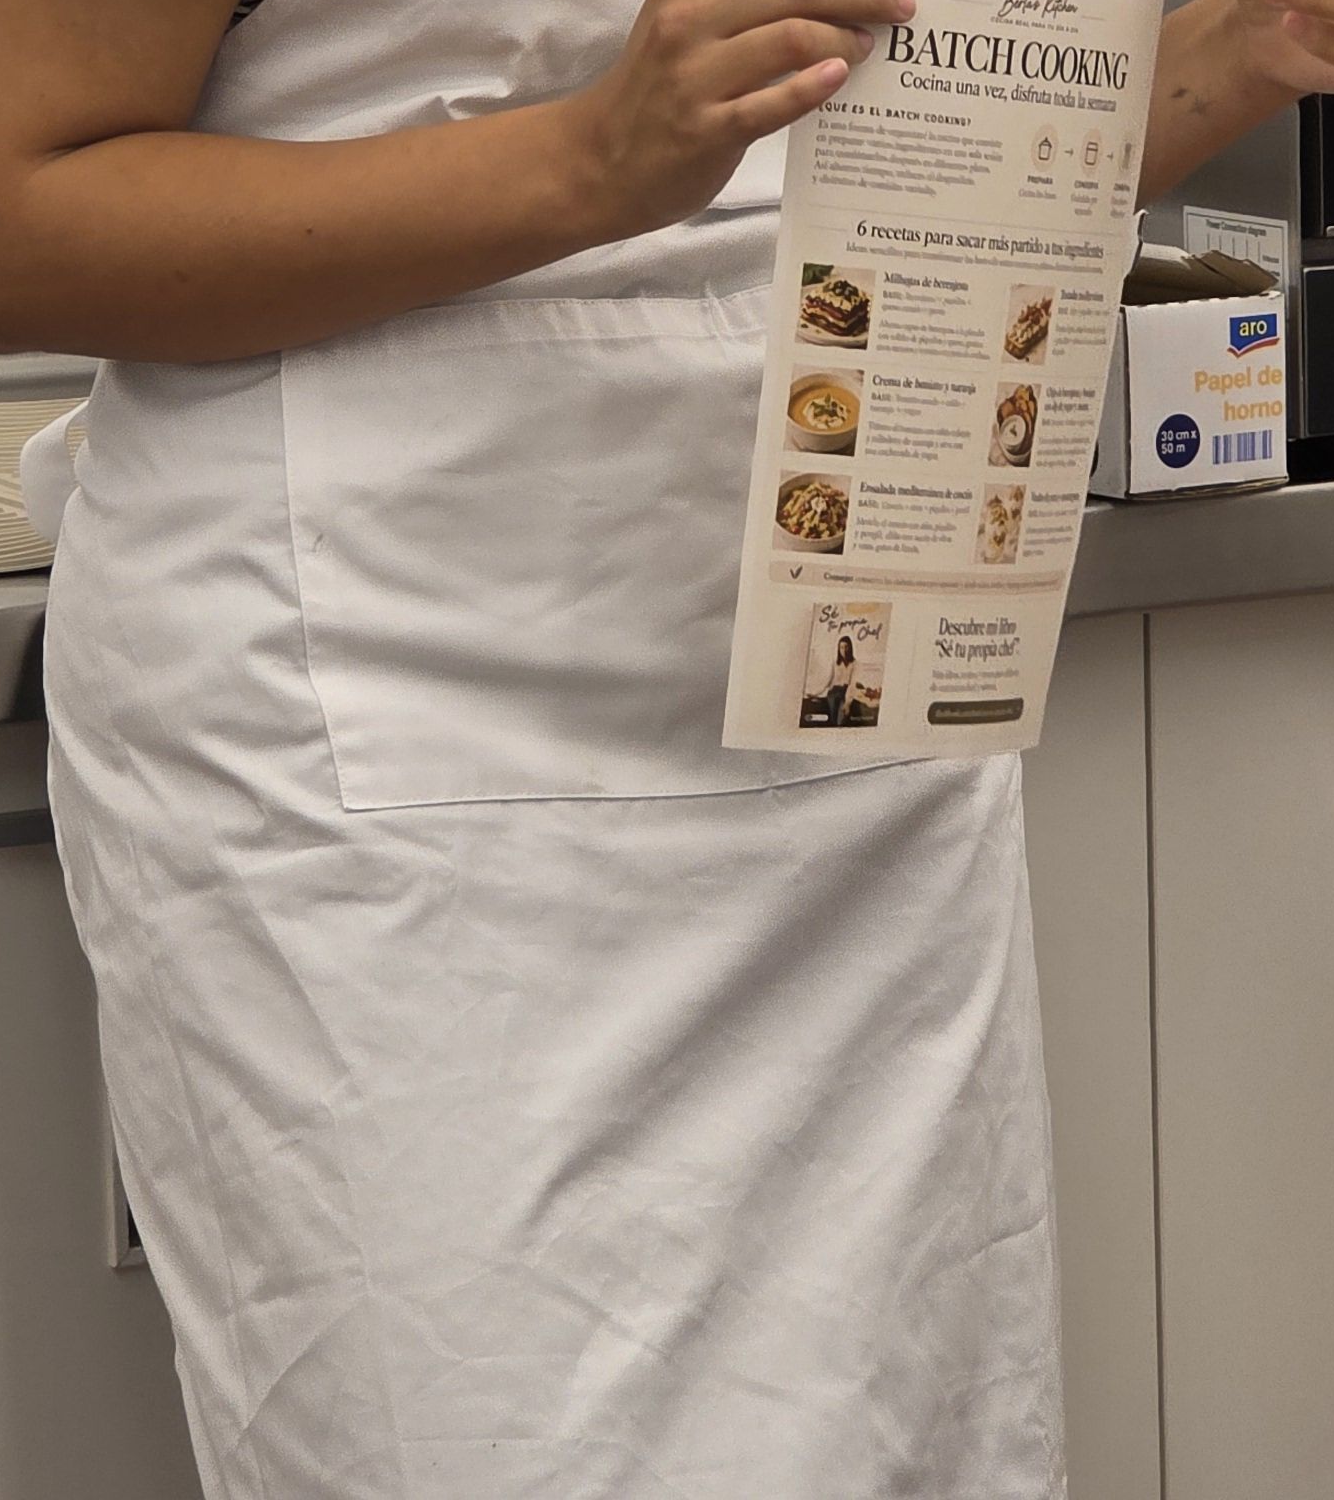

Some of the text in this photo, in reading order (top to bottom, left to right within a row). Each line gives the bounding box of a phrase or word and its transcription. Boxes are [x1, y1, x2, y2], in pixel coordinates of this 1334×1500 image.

[885, 24, 1130, 90] BATCH COOKING
[900, 70, 952, 94] Cocina
[955, 80, 981, 98] una
[983, 83, 1008, 102] vez,
[1010, 83, 1053, 105] disfruta
[1053, 90, 1076, 108] toda
[851, 104, 865, 114] ES
[869, 106, 880, 117] EL
[886, 108, 920, 121] BATCH
[924, 113, 972, 127] COOKING?
[857, 220, 867, 237] 6
[871, 225, 921, 242] recetas
[923, 231, 954, 247] para
[956, 234, 987, 249] sacar
[988, 235, 1009, 251] más
[1010, 237, 1043, 256] partido
[1044, 243, 1050, 255] a
[1239, 319, 1268, 337] aro
[902, 377, 913, 388] de
[1194, 364, 1283, 395] Papel de
[1224, 400, 1283, 421] horno
[1161, 429, 1197, 441] 30 cm x
[1161, 443, 1186, 455] 50 m
[819, 604, 840, 623] Sé
[939, 617, 1017, 636] Descubre mi libro
[954, 642, 966, 658] tu
